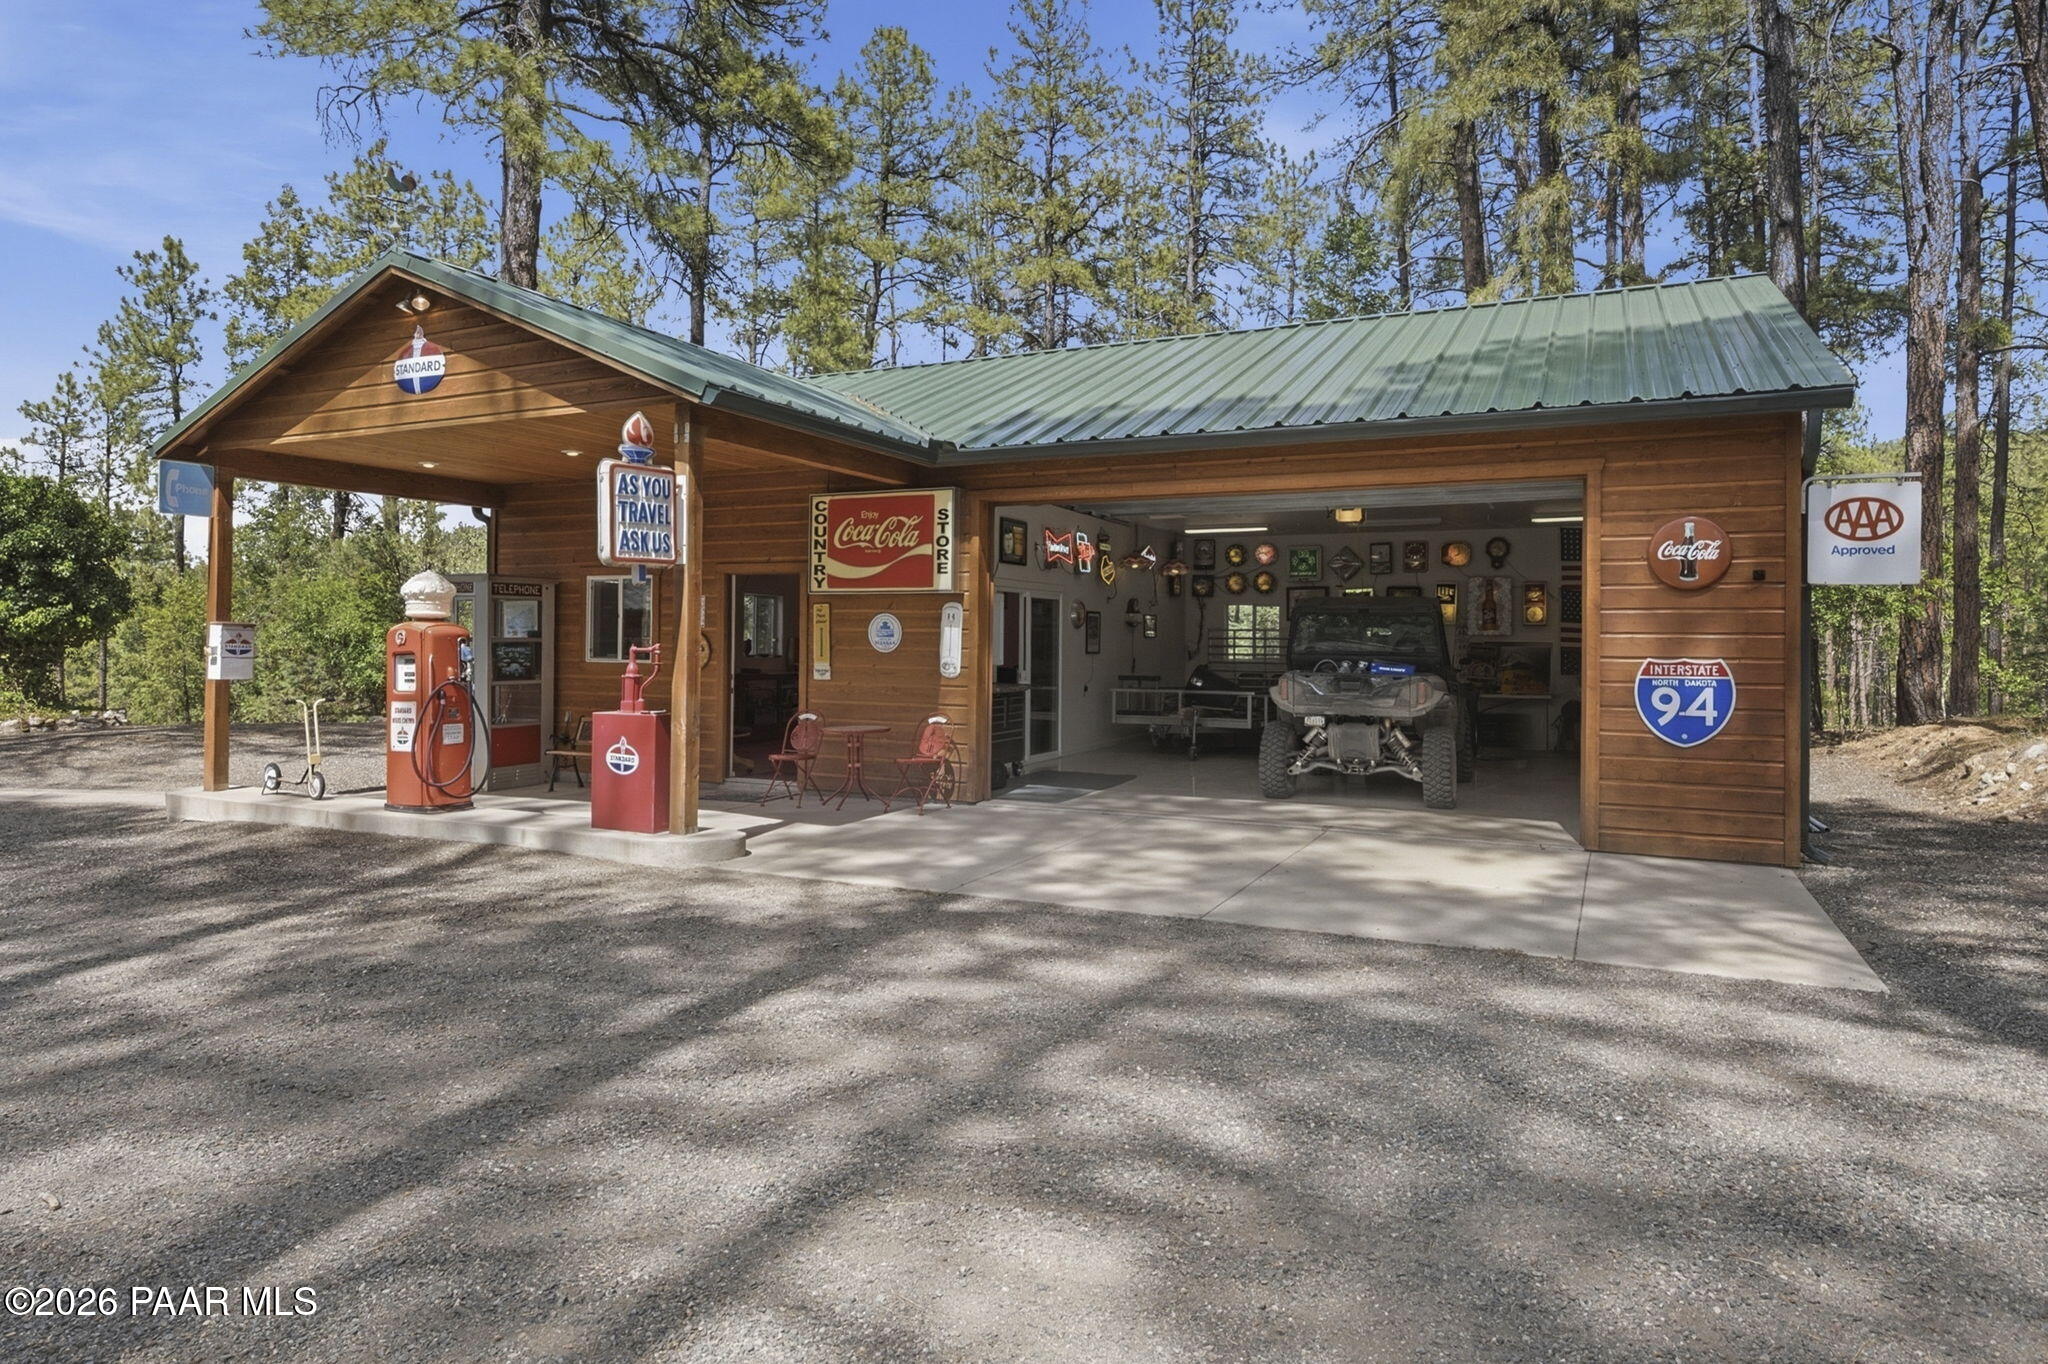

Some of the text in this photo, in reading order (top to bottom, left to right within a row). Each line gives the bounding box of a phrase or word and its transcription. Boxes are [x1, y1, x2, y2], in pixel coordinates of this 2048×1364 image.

[395, 360, 441, 376] STANDARD
[618, 473, 671, 499] AS YOU
[617, 500, 672, 525] TRAVEL
[860, 510, 880, 520] Enjoy
[1834, 500, 1896, 539] AAA
[619, 529, 671, 554] ASK US
[813, 500, 828, 589] COUNTRY
[936, 508, 950, 575] STORE
[1831, 545, 1896, 557] Approved
[493, 583, 541, 596] TELEPHONE
[1650, 664, 1720, 676] INTERSTATE
[1652, 679, 1717, 688] NORTH DAKOTA
[1651, 687, 1718, 727] 94
